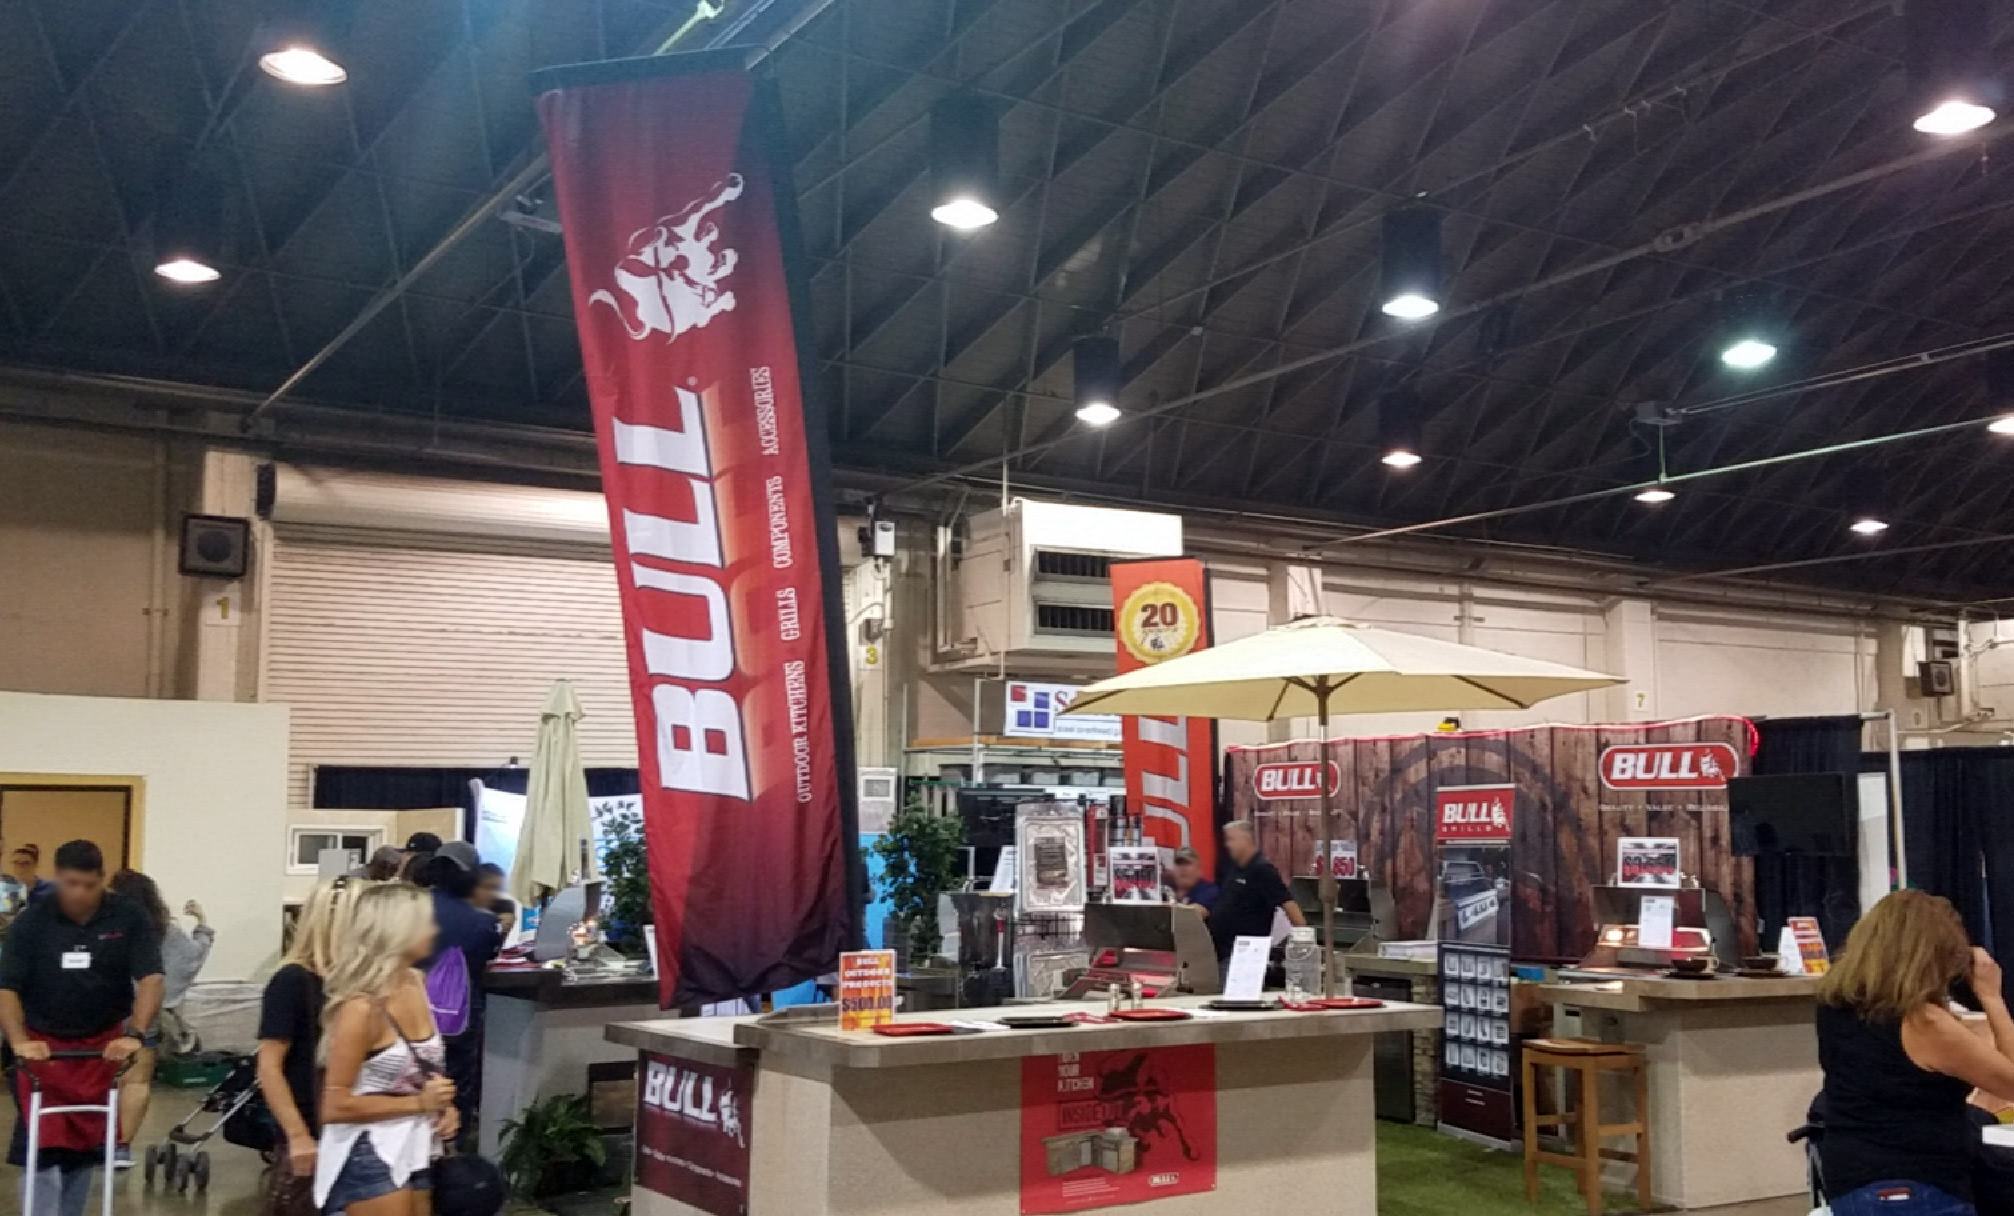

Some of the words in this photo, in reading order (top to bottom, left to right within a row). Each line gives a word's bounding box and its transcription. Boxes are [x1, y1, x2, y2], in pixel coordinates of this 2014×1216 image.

[749, 366, 780, 457] ACCESSORIES
[766, 475, 794, 569] COMPONENTS
[612, 386, 750, 802] BULL
[775, 587, 801, 641] GRILLS
[1140, 602, 1178, 628] 20
[865, 644, 879, 665] 3
[783, 659, 809, 735] KITCHENS
[787, 735, 813, 804] OUTDOOR
[1261, 767, 1316, 792] BULL
[1610, 751, 1699, 780] BULL
[1442, 802, 1493, 824] BULL
[643, 1060, 718, 1123] BULL
